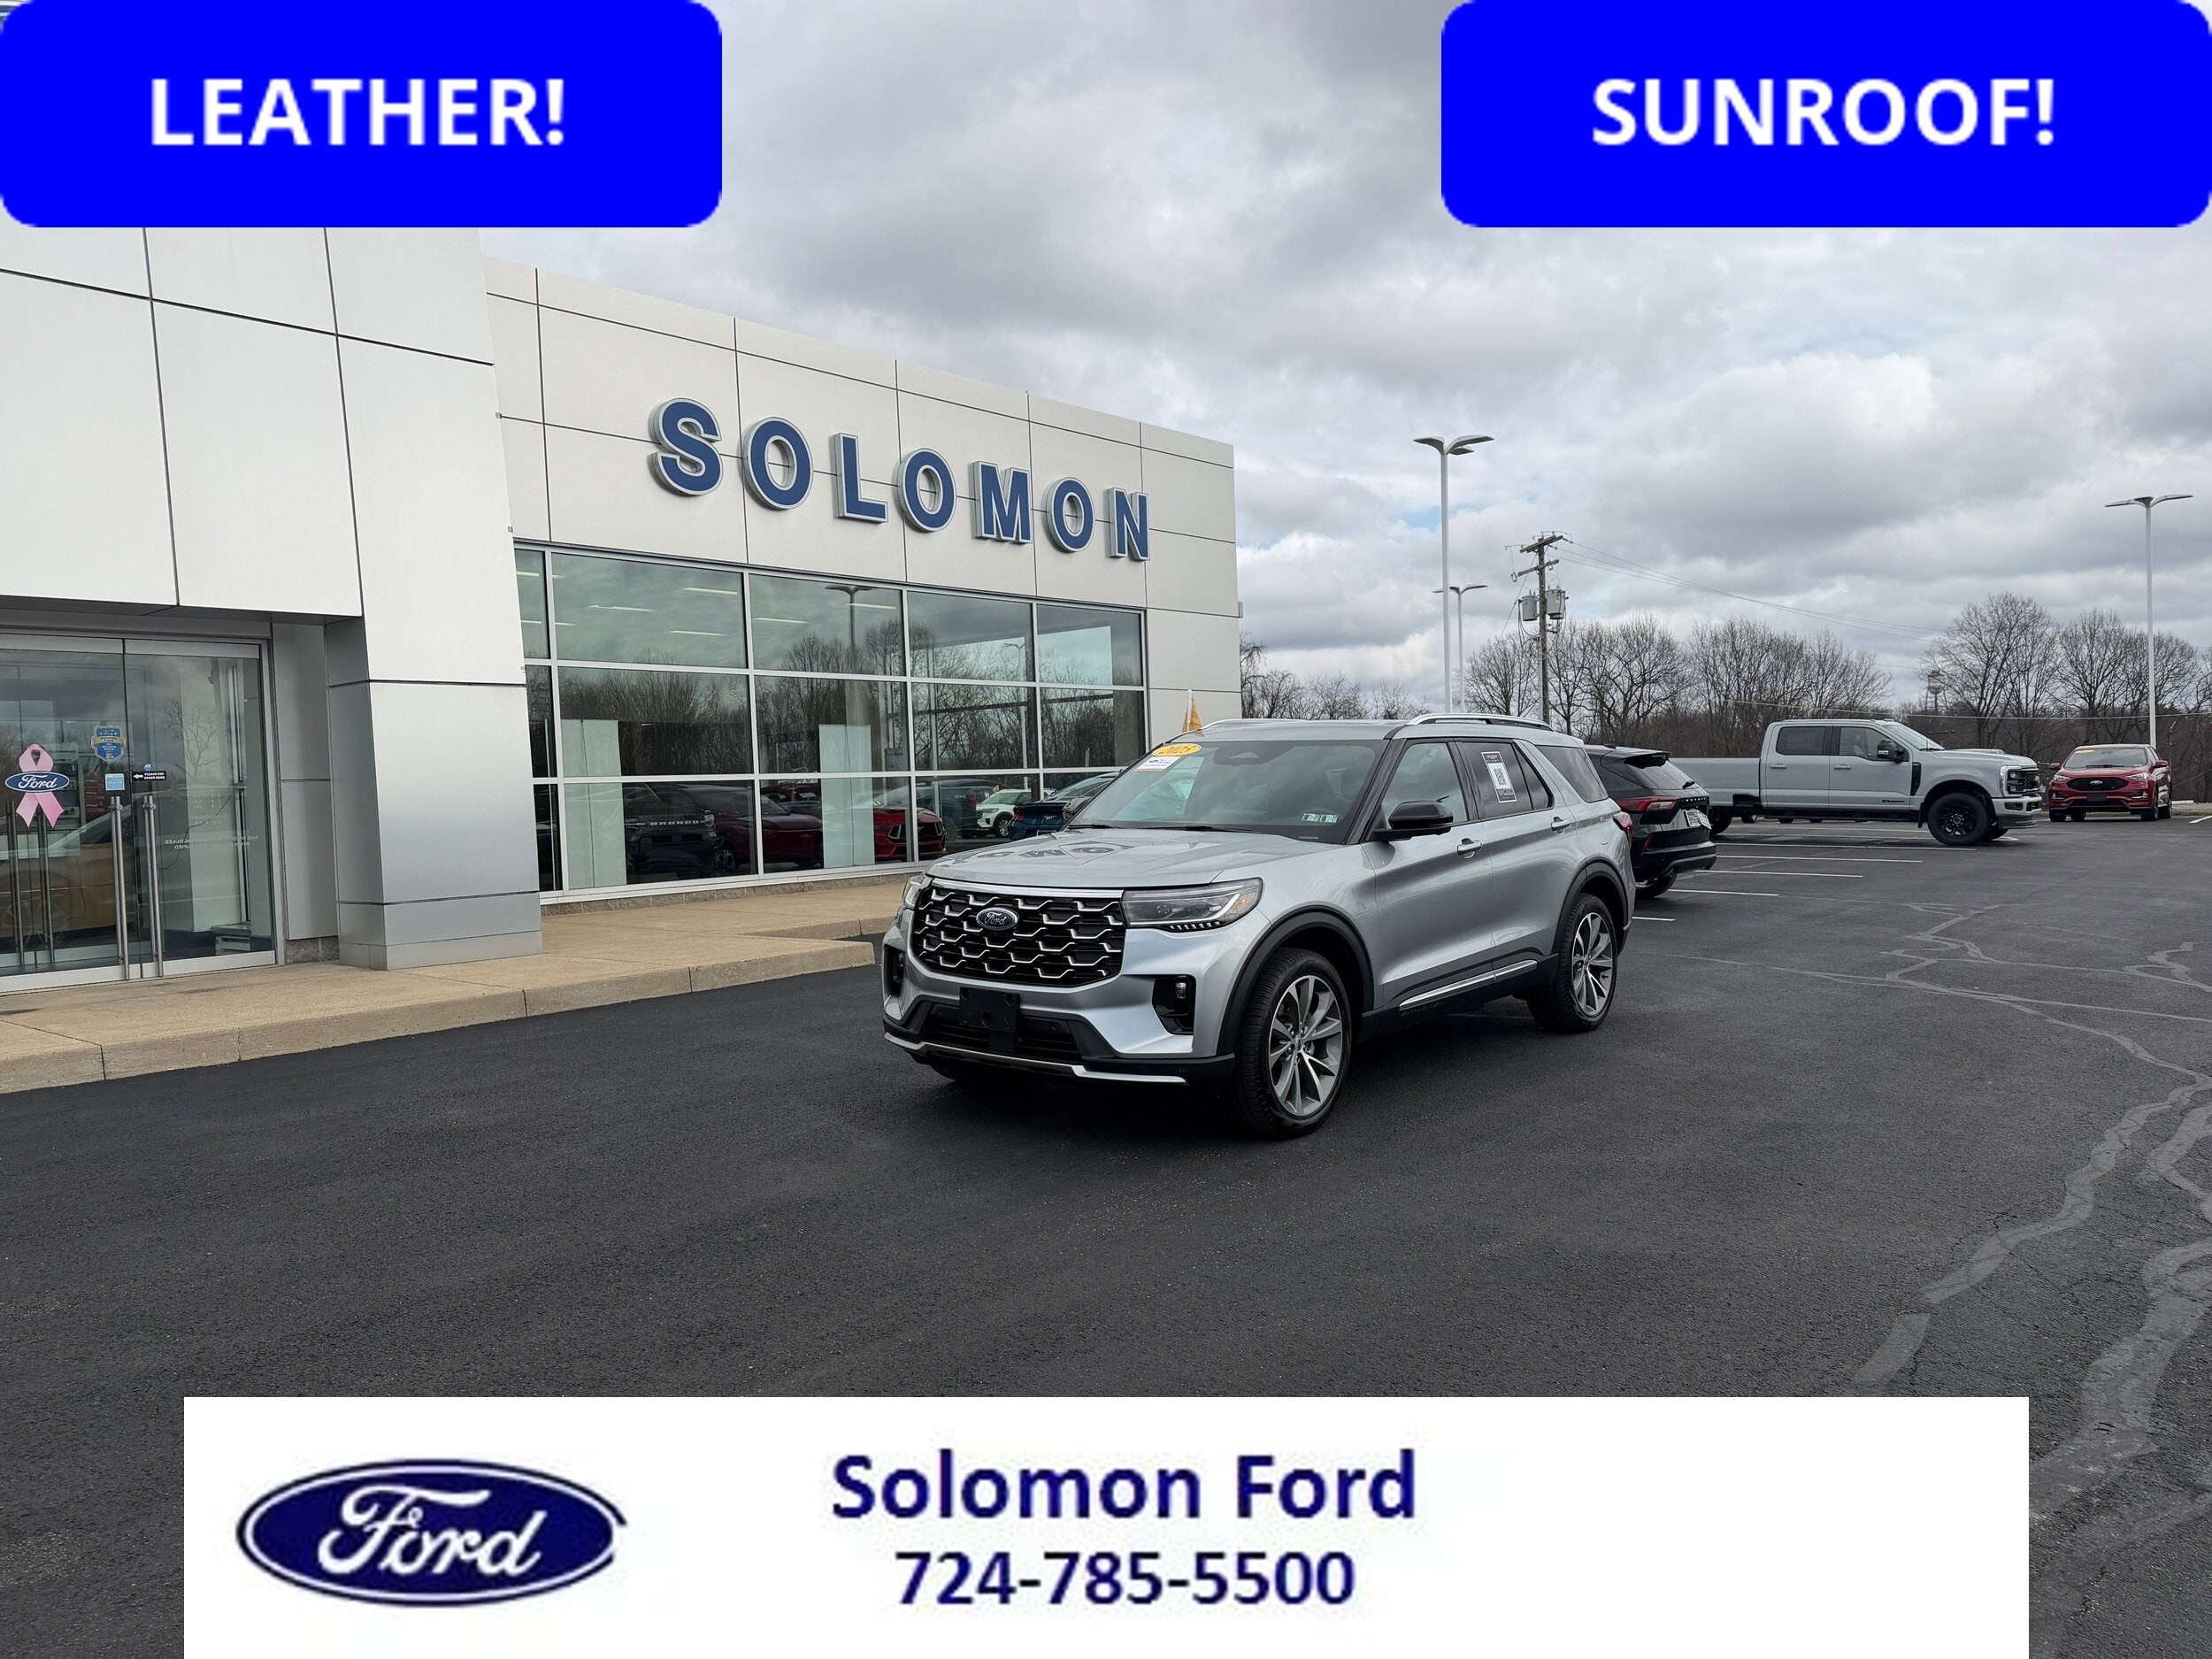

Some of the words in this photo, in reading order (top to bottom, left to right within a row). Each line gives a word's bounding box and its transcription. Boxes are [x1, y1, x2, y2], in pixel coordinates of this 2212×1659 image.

[650, 397, 1151, 561] SOLOMON
[18, 774, 58, 789] Ford
[984, 911, 1007, 926] Ford
